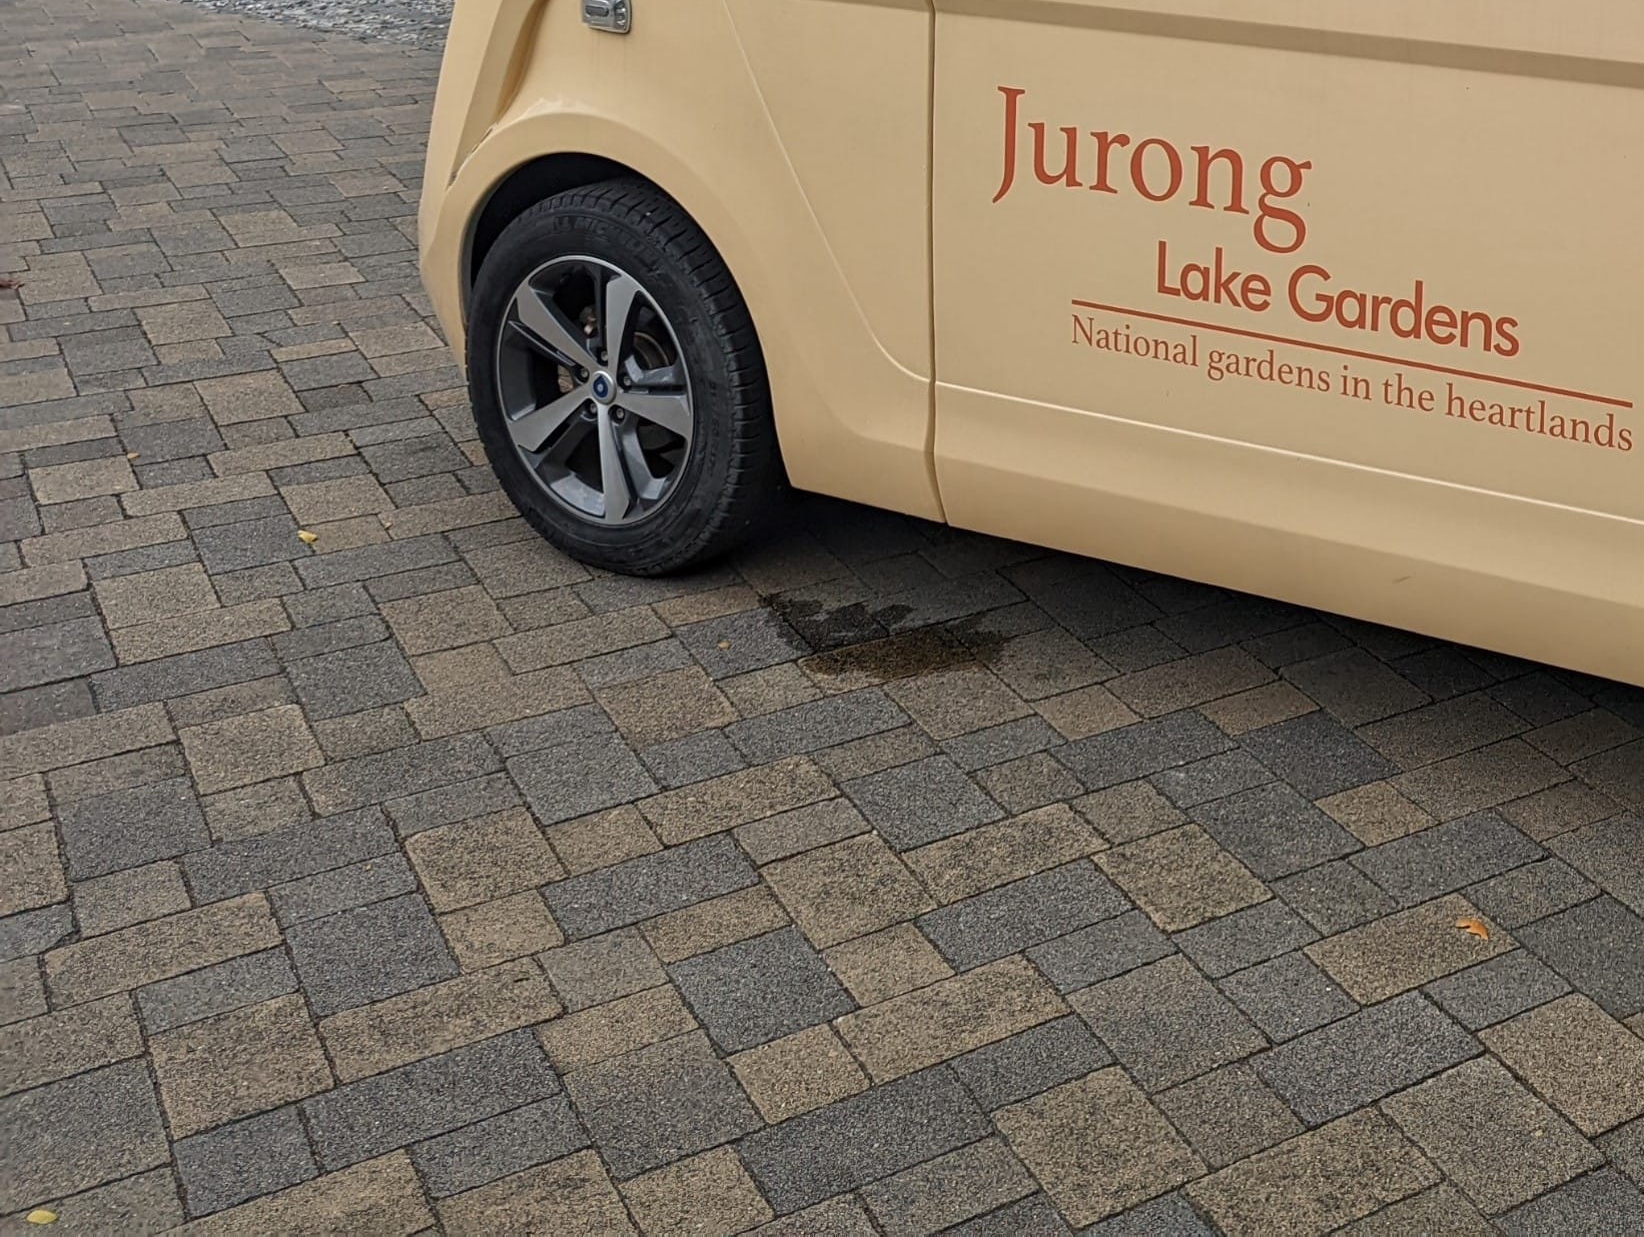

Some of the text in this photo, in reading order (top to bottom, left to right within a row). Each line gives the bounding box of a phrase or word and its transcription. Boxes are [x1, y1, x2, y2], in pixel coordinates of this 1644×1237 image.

[992, 86, 1312, 254] Jurong
[1157, 240, 1520, 357] Lake Gardens
[1071, 314, 1634, 452] National gardens in the heartlands
